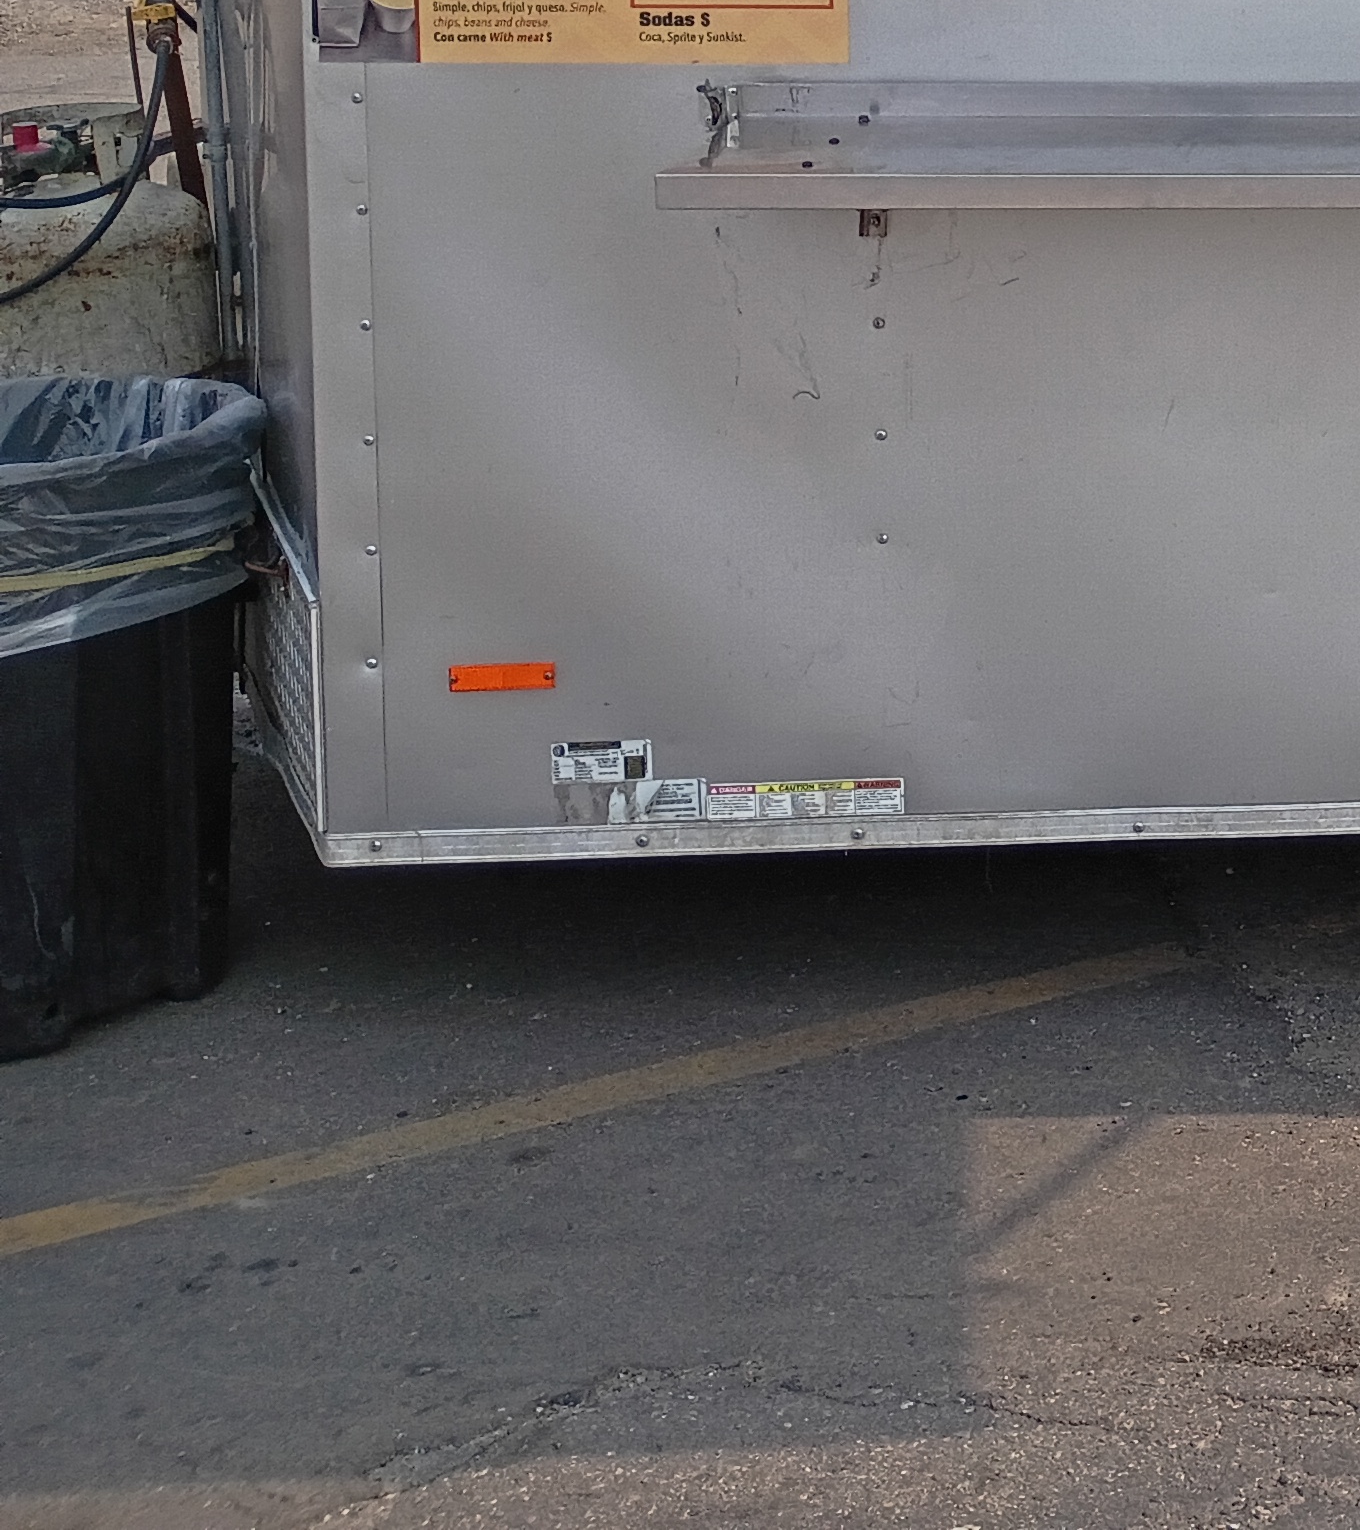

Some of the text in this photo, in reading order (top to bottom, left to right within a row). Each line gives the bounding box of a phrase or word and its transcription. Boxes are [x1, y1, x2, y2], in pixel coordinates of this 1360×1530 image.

[639, 12, 695, 26] Sodas
[434, 32, 454, 42] Con
[490, 32, 514, 42] With
[517, 32, 544, 42] meat
[639, 32, 746, 45] Coca, Sprite y Sunkist.
